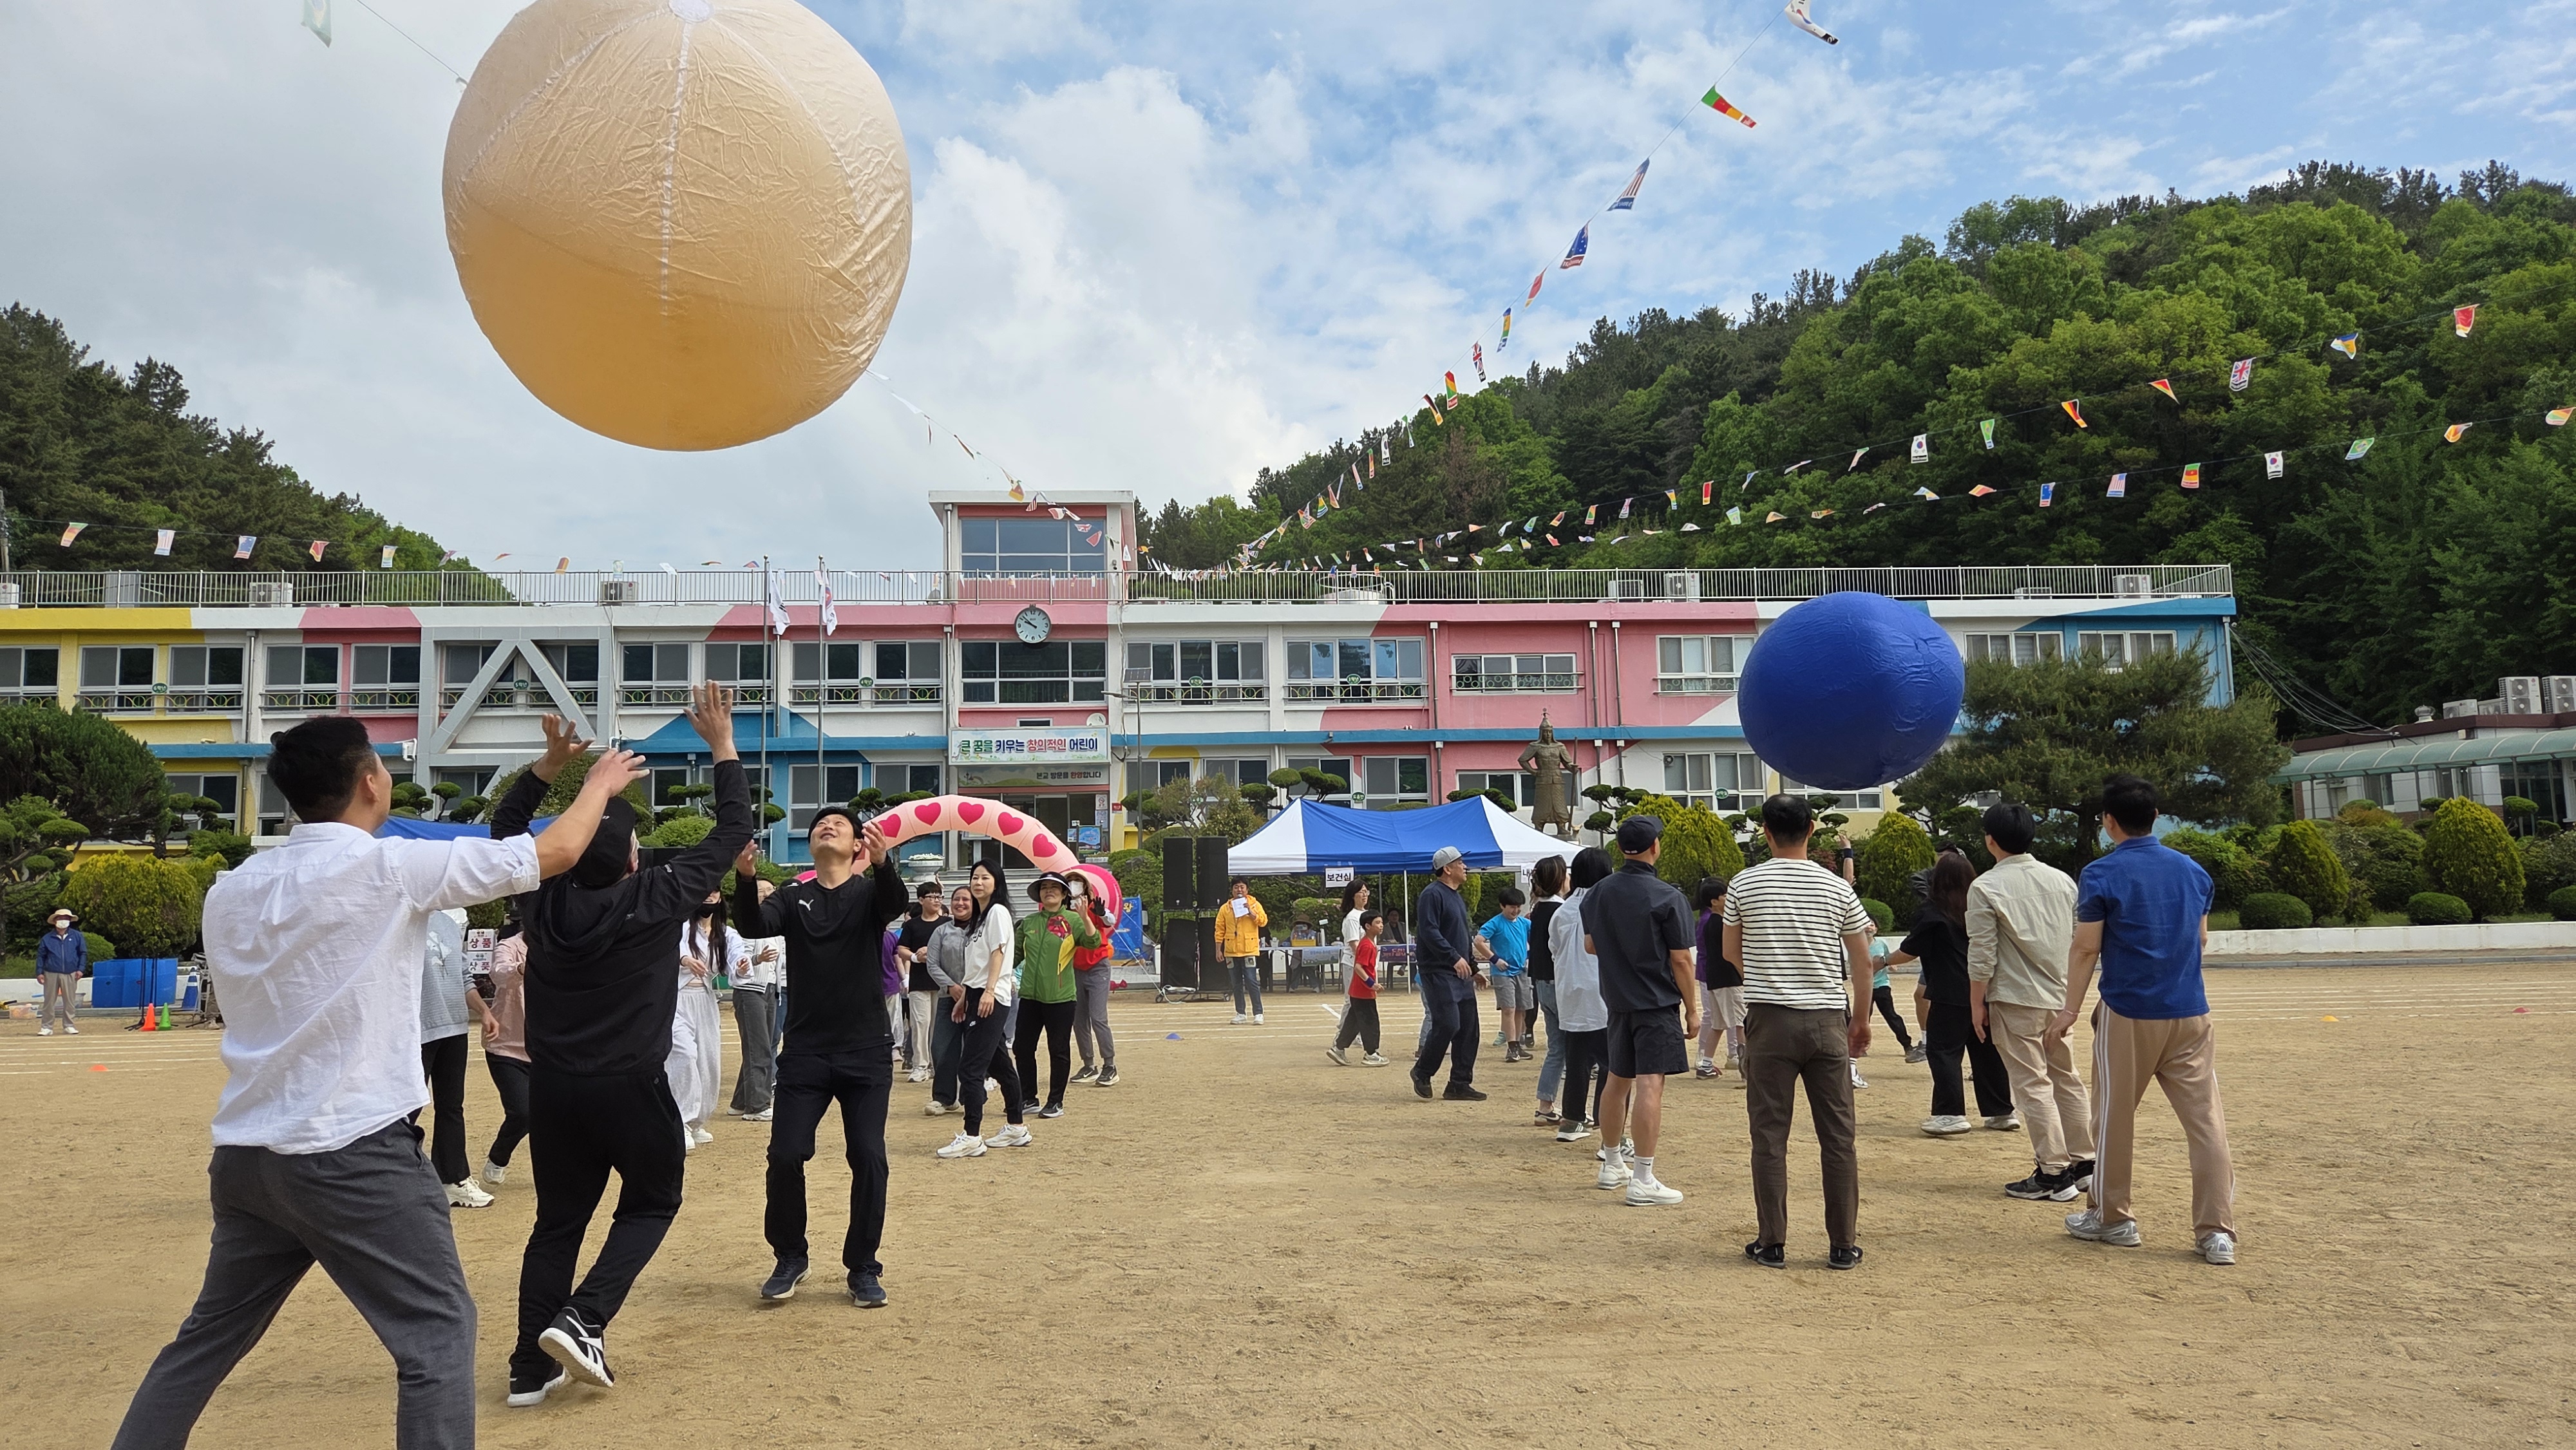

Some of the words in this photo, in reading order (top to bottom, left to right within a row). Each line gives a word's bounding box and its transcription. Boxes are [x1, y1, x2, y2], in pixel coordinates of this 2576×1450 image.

[961, 740, 971, 752] 큰
[974, 740, 992, 752] 꿈을
[996, 739, 1025, 752] 키우는
[1027, 739, 1066, 751] 창의적인
[1069, 738, 1098, 751] 어린이
